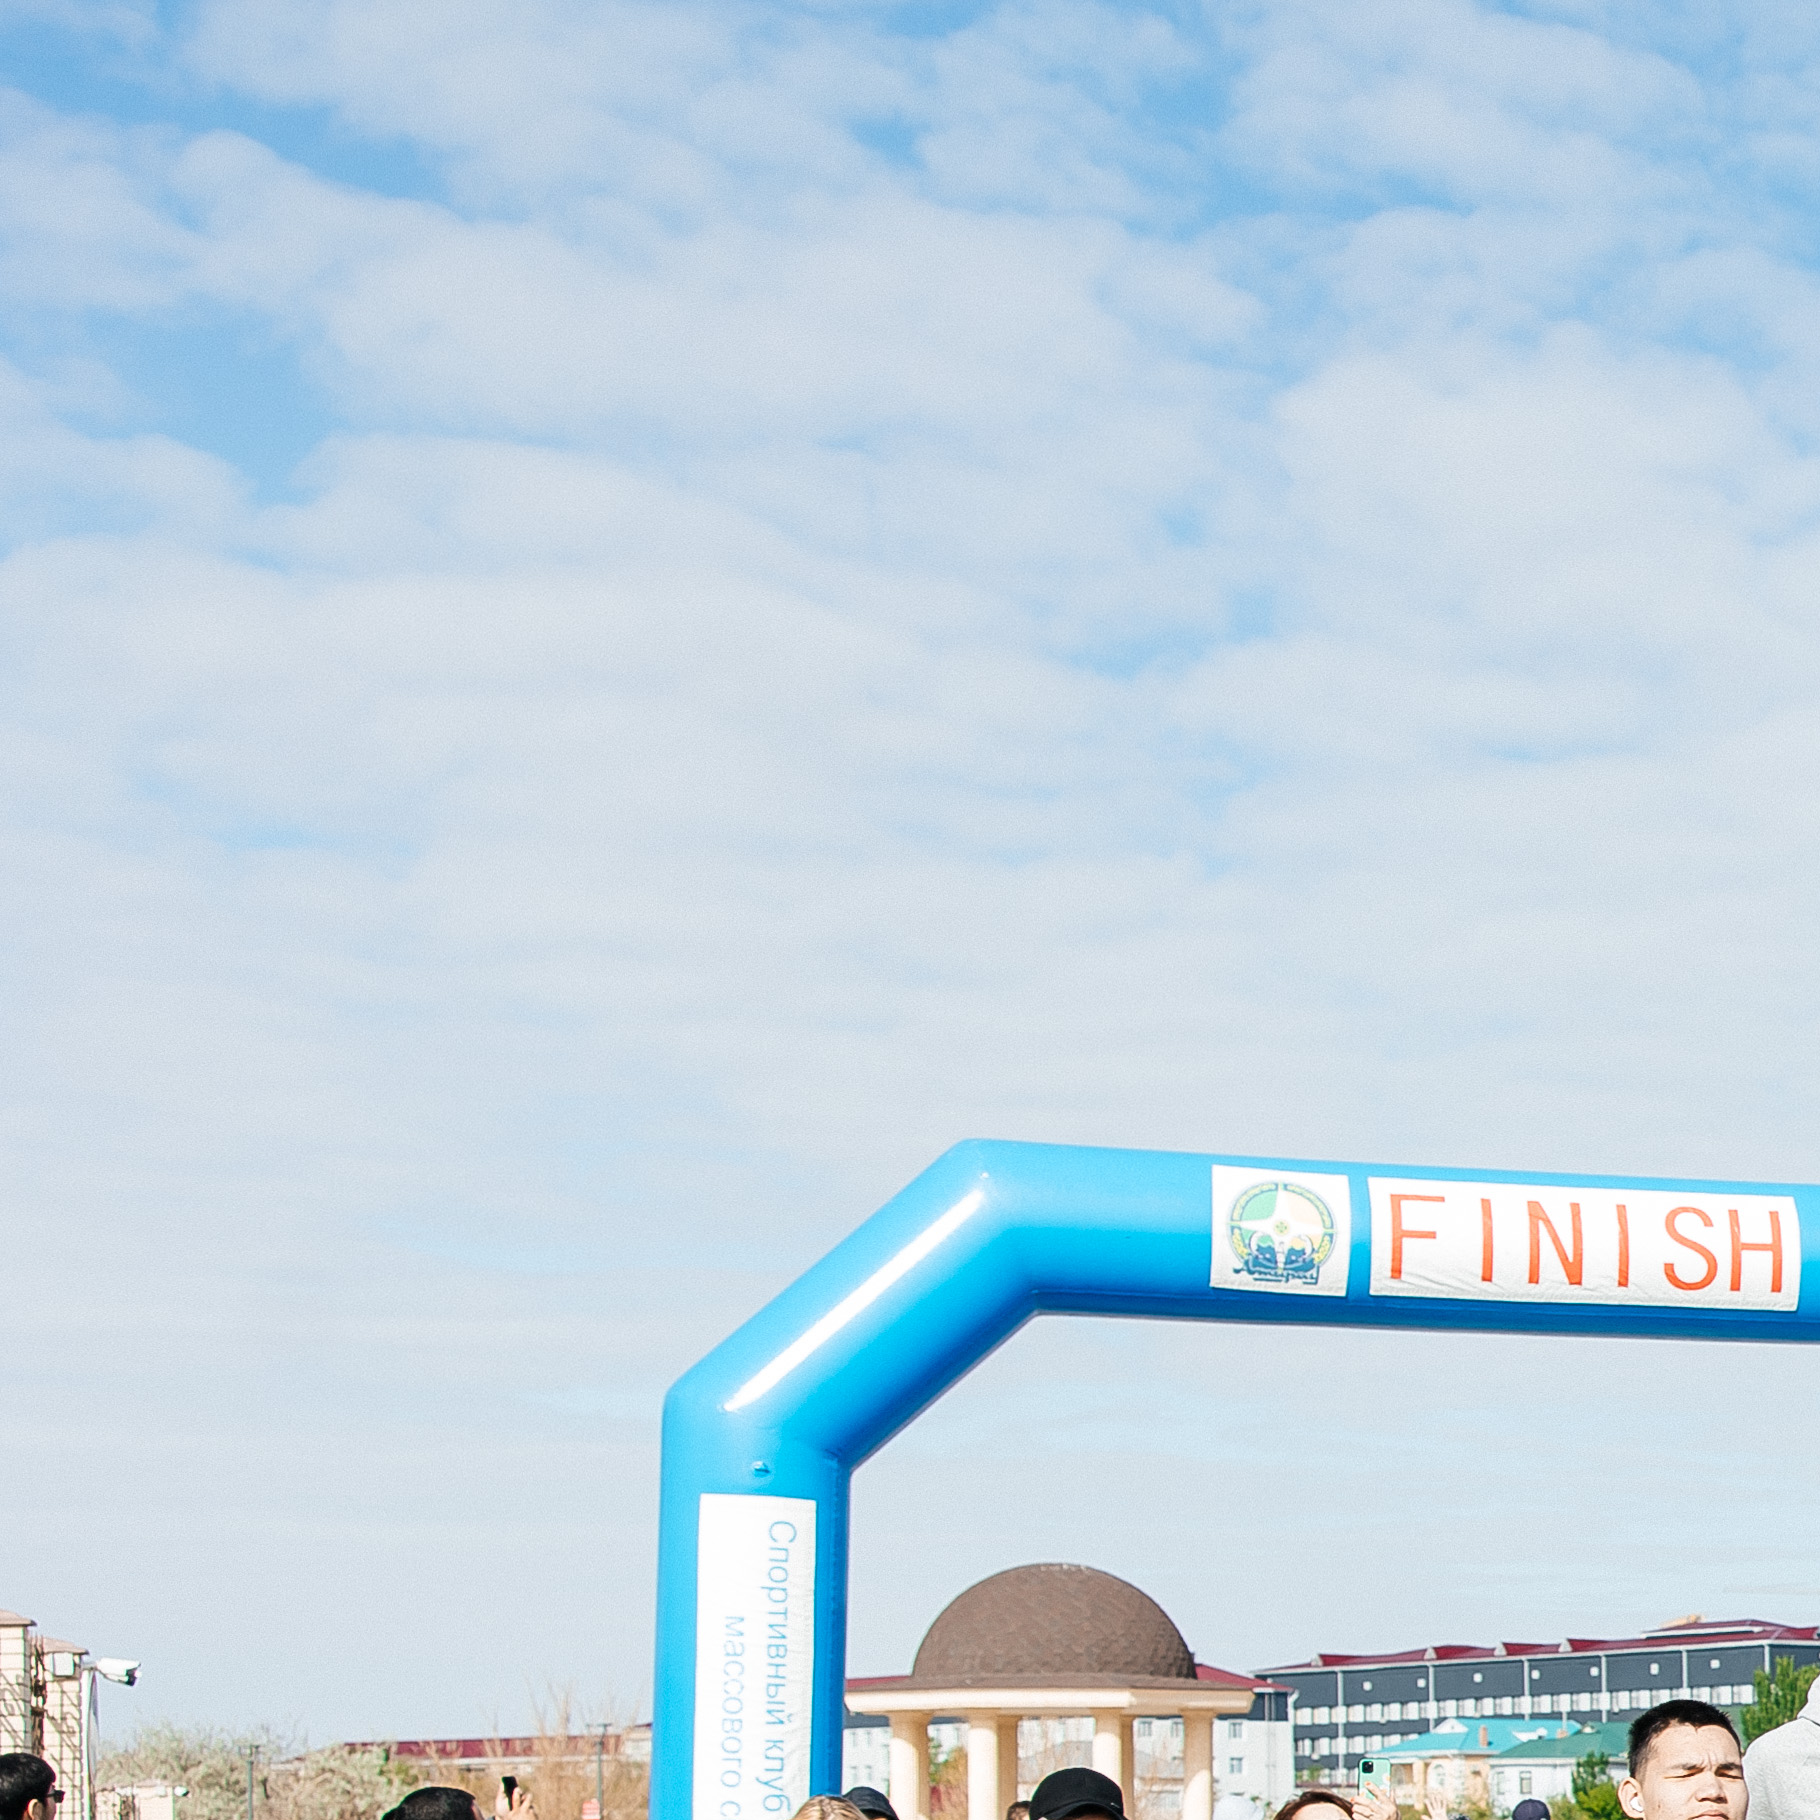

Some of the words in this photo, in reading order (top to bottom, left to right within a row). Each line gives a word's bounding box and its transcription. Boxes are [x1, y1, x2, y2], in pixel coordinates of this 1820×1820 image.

[1390, 1194, 1783, 1293] FINISH
[759, 1520, 797, 1726] Спортивный
[721, 1615, 745, 1788] массового
[756, 1739, 791, 1812] клуб
